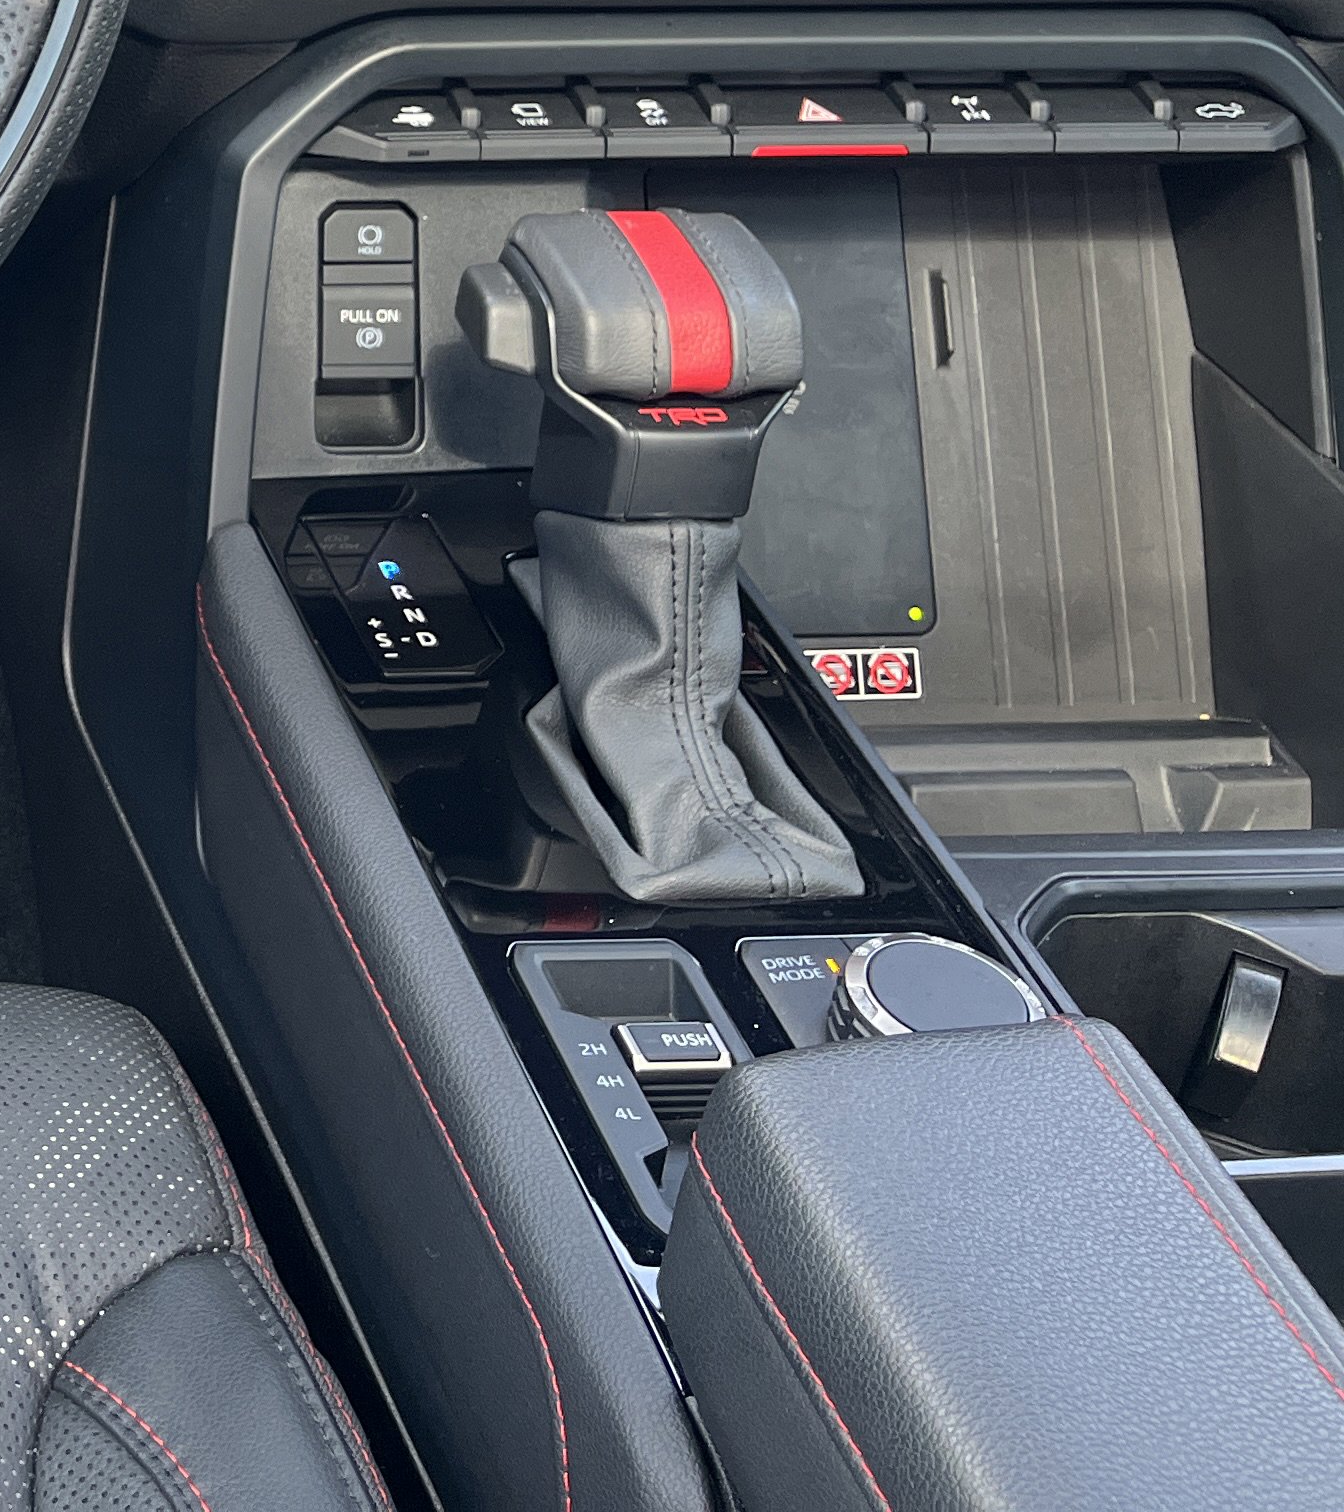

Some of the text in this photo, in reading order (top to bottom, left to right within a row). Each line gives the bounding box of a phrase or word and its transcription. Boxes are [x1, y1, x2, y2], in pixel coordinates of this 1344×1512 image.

[357, 246, 382, 256] HOLD
[375, 308, 399, 324] ON
[637, 407, 730, 427] TRD
[377, 560, 401, 580] P
[390, 584, 415, 601] R
[403, 607, 428, 624] N
[374, 631, 438, 649] S D
[761, 954, 817, 973] DRIVE
[768, 966, 826, 986] MODE
[660, 1032, 714, 1049] PUSH
[577, 1042, 608, 1058] 2H
[595, 1074, 625, 1090] 4H
[614, 1106, 642, 1122] 4L
